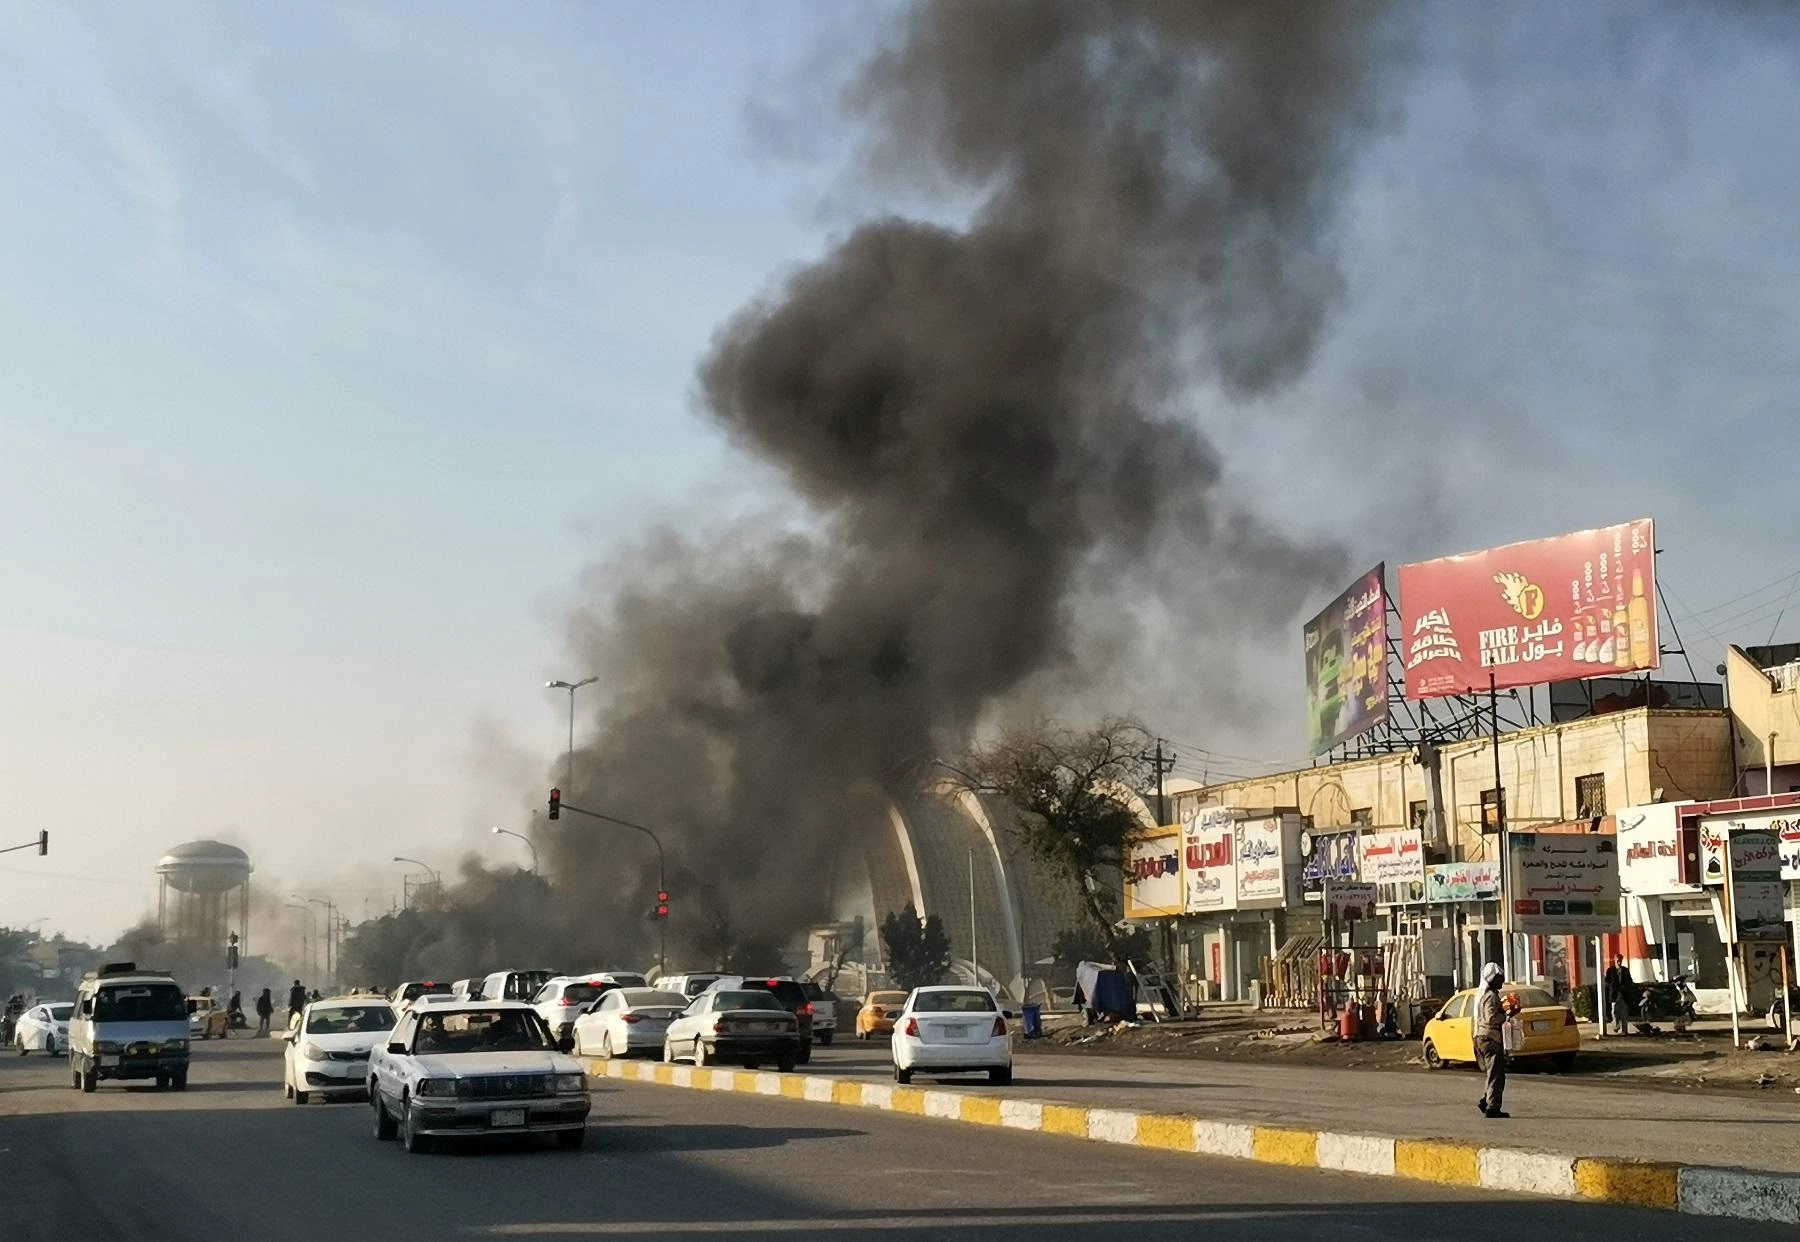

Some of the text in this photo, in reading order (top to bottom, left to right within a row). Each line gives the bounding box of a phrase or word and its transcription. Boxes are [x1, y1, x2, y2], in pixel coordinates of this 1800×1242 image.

[1614, 532, 1622, 557] 1000
[1632, 528, 1640, 554] 1000
[1479, 626, 1519, 649] FIRE
[1521, 617, 1563, 643] فاير
[1480, 646, 1520, 668] BALL
[1522, 640, 1563, 662] بول
